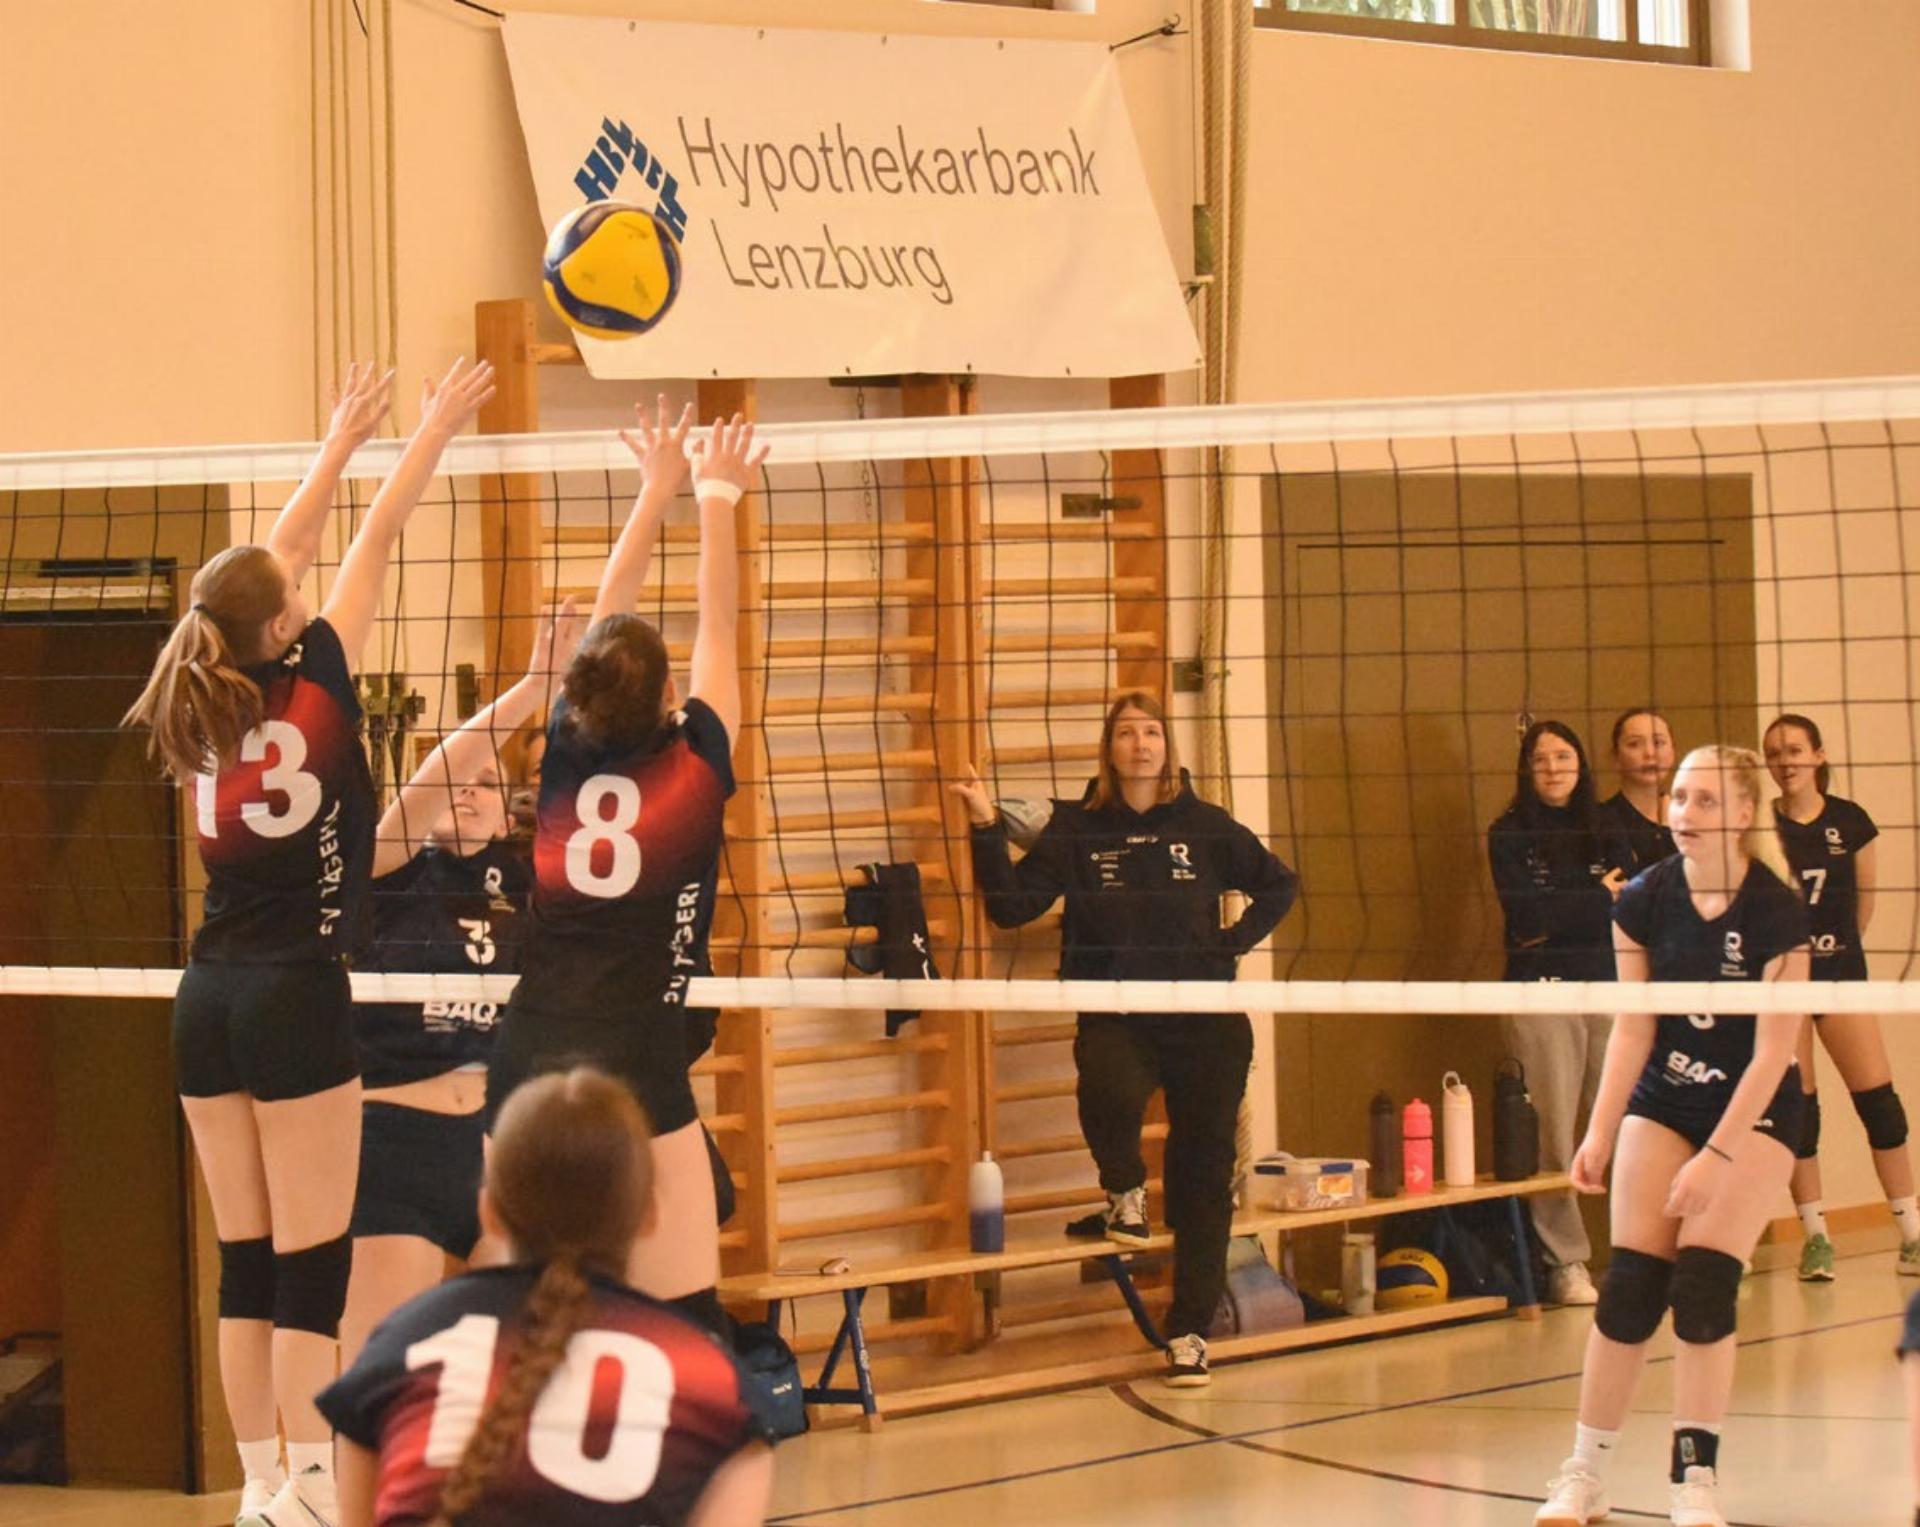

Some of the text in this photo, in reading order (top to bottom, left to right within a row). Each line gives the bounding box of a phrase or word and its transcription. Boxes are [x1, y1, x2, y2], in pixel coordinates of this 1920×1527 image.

[677, 116, 1100, 212] Hypothekarbank
[709, 218, 954, 305] Lenzburg
[195, 719, 323, 838] 13
[564, 773, 642, 899] 8
[1801, 868, 1827, 905] 7
[457, 917, 497, 966] 3
[422, 1000, 499, 1026] BAQ
[405, 1313, 676, 1503] 10
